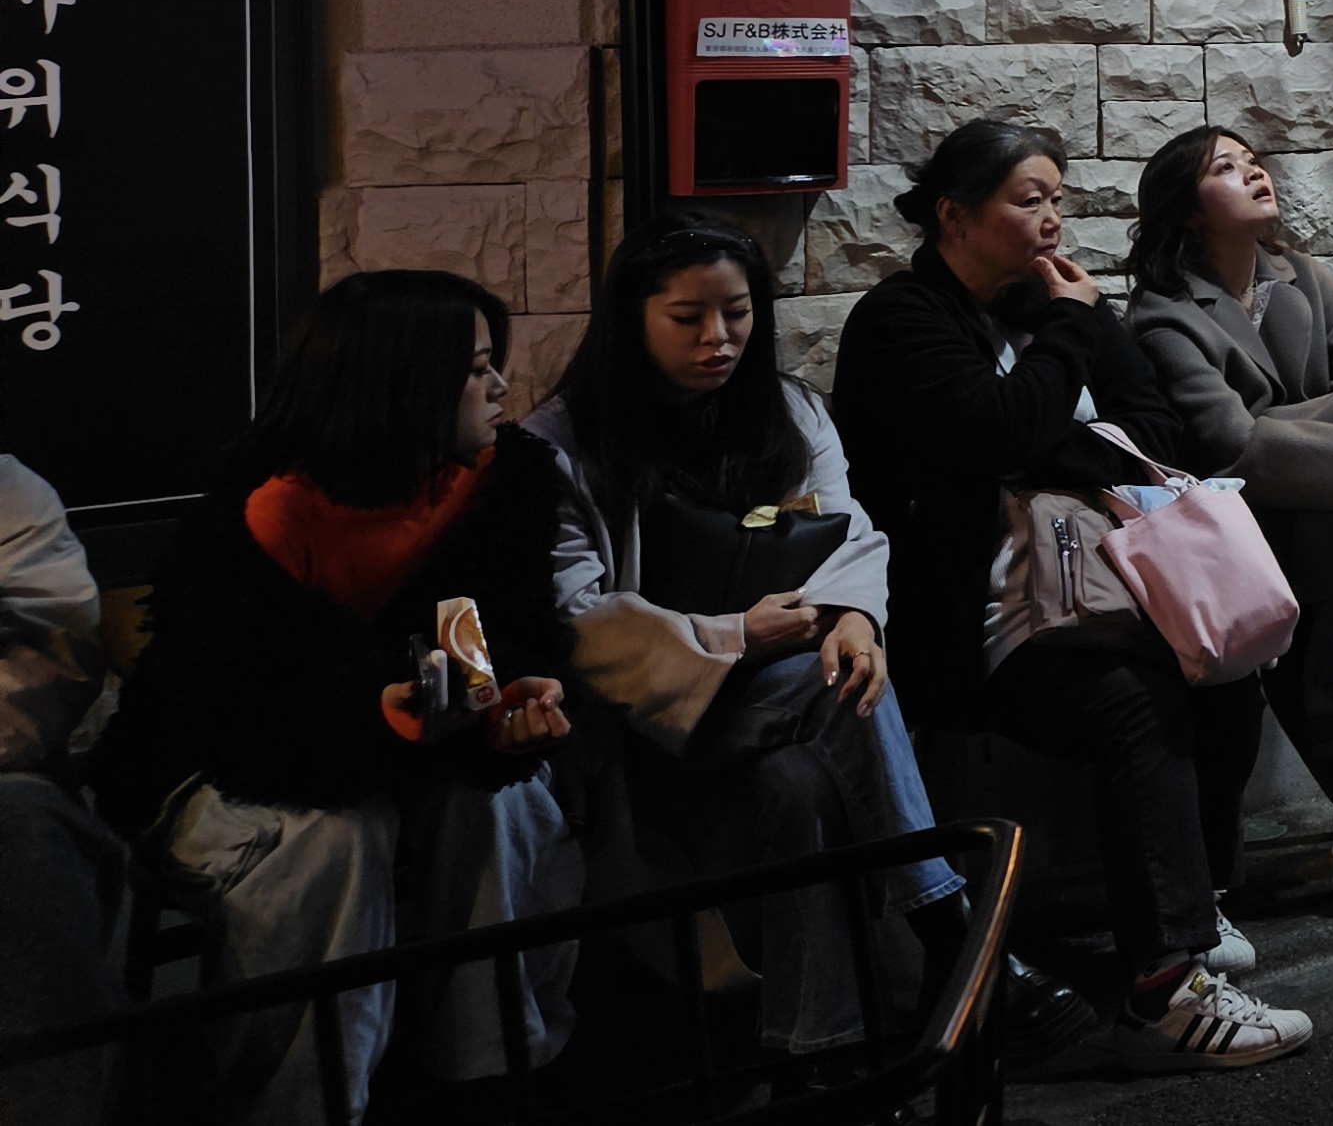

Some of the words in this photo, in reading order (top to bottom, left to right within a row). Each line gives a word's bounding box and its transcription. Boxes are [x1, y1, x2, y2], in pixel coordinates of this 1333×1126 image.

[704, 22, 727, 38] SJ
[733, 21, 847, 41] F&B株式会社
